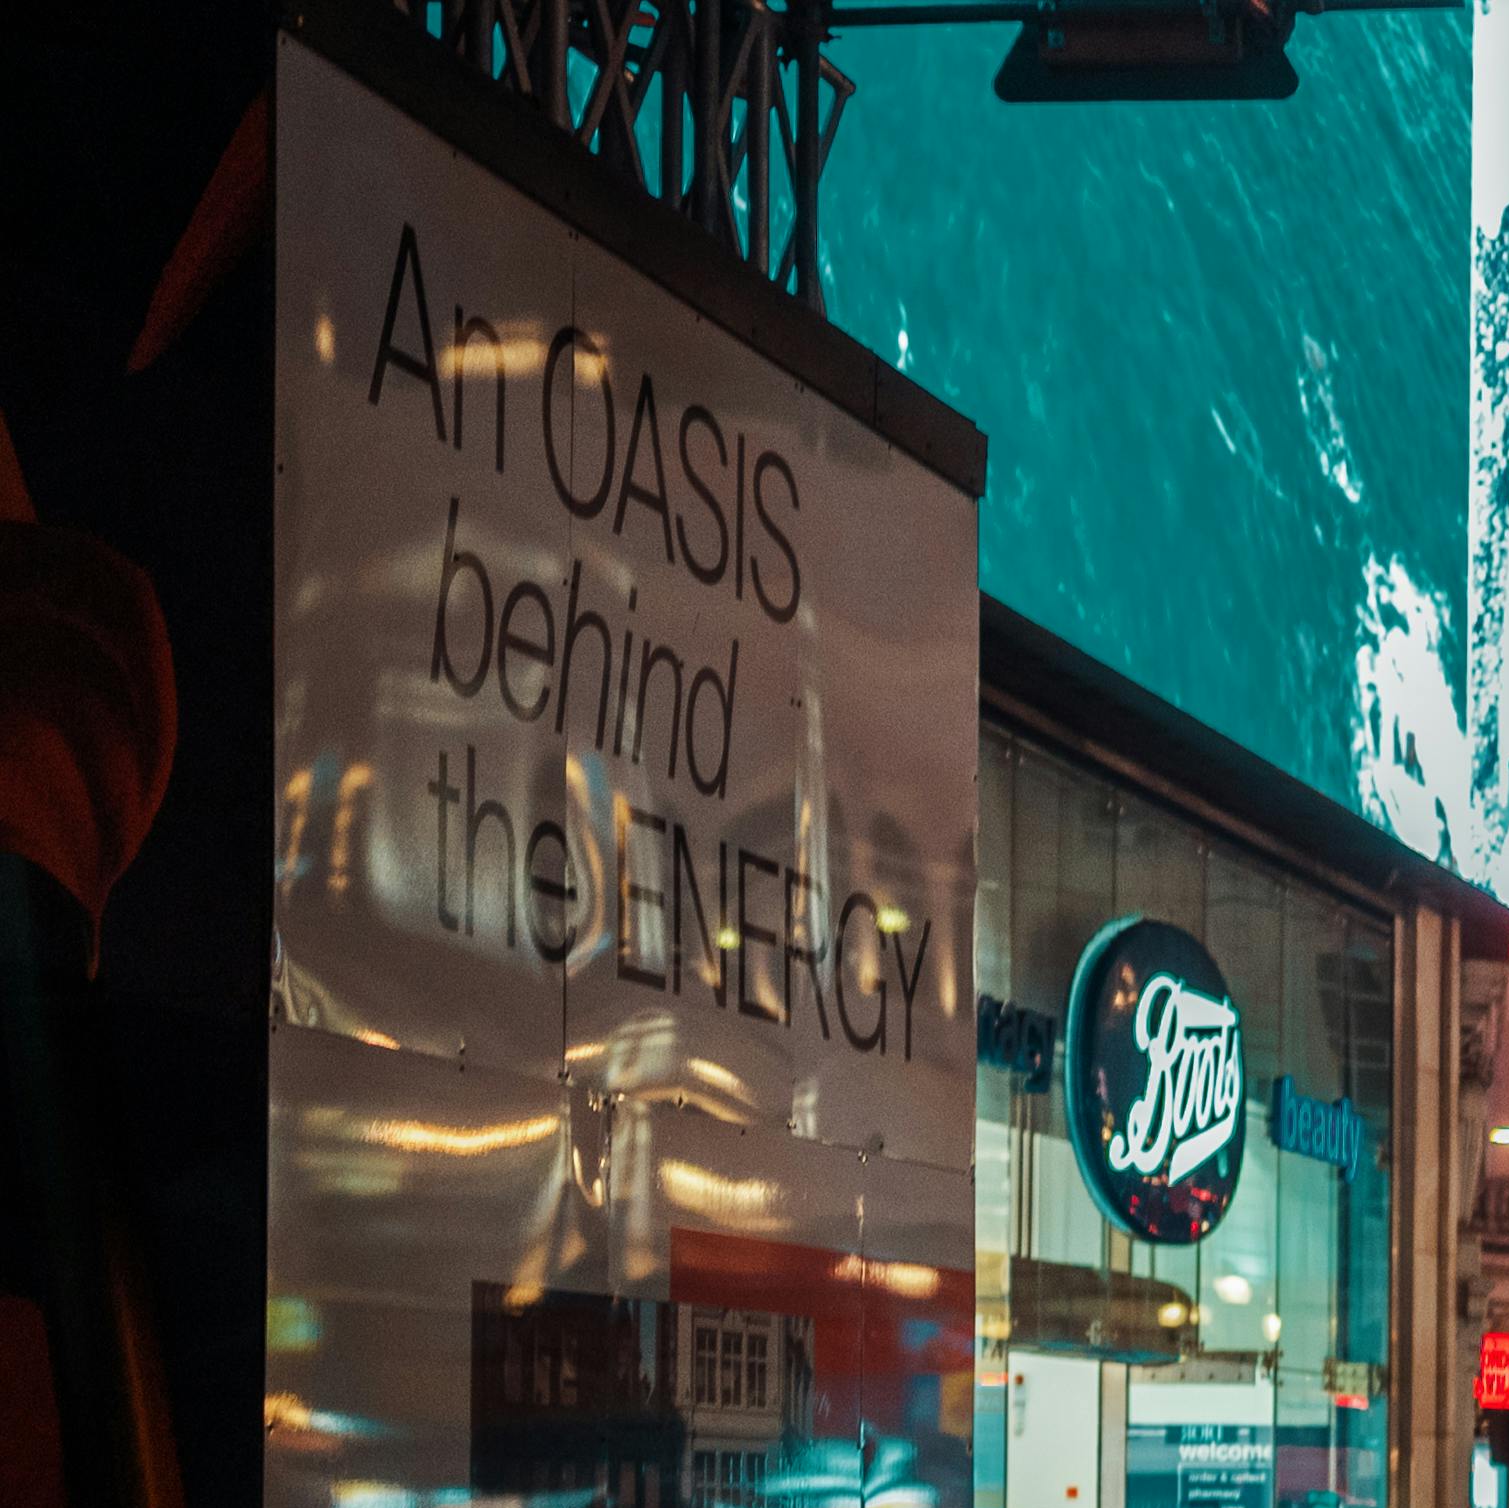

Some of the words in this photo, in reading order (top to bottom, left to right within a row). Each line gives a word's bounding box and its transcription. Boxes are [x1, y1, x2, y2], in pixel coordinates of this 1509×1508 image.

[367, 221, 506, 473] An
[541, 325, 801, 625] OASIS
[429, 496, 739, 800] behind
[427, 744, 577, 963] the
[615, 804, 932, 1063] ENERGY
[1108, 972, 1240, 1188] Boots
[1279, 1073, 1363, 1184] beauty
